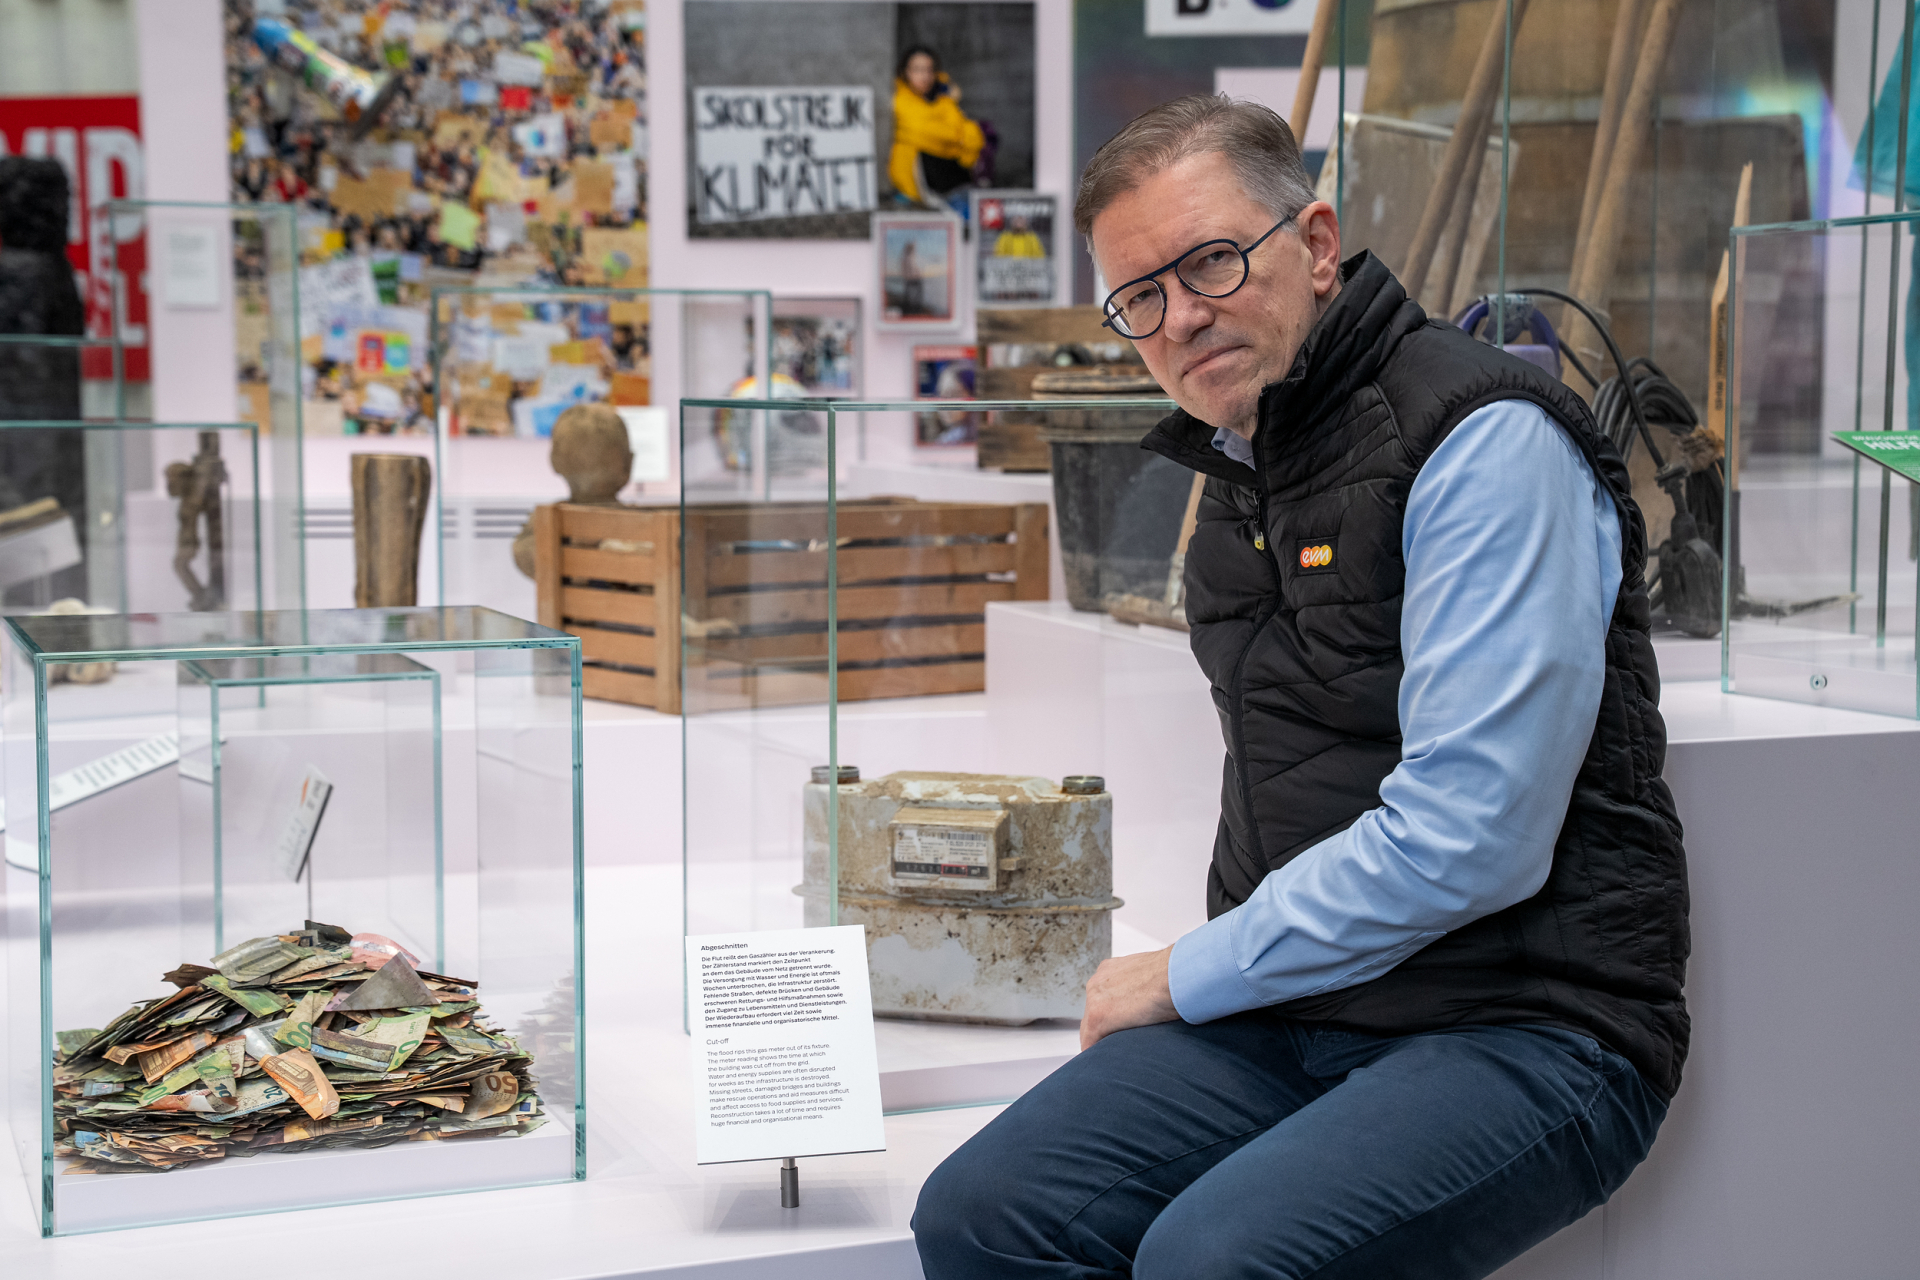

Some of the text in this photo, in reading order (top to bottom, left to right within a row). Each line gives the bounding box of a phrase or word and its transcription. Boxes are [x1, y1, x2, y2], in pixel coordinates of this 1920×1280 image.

[698, 94, 871, 131] SKOLSTREJK
[696, 155, 876, 219] KLIMATET
[1302, 548, 1331, 564] evm
[701, 943, 748, 951] Abgeschnitten
[484, 1074, 517, 1095] 50
[264, 1086, 283, 1100] 20
[762, 1115, 802, 1123] organisational
